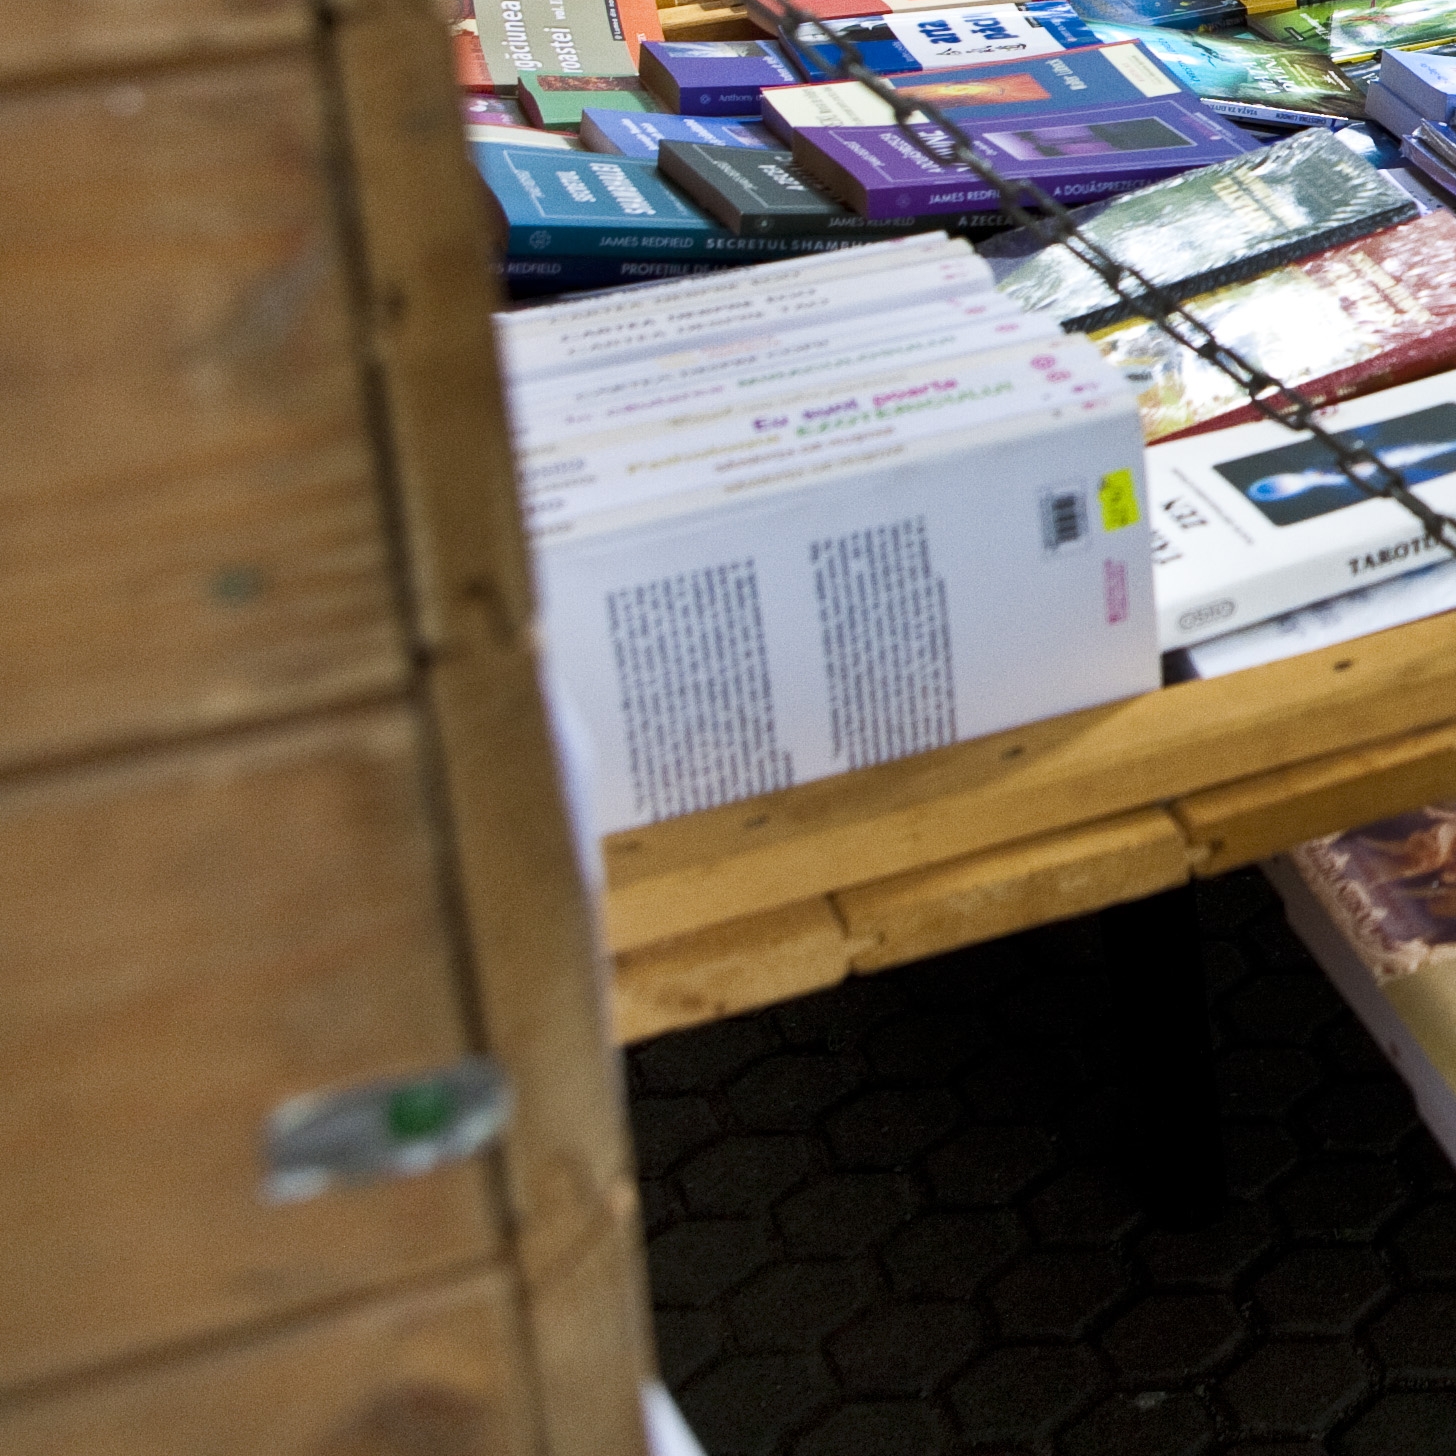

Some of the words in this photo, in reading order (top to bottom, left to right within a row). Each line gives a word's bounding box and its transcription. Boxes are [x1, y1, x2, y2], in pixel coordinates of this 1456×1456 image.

[911, 19, 962, 46] arta
[929, 192, 964, 204] JAMES
[1053, 185, 1062, 197] A
[830, 216, 862, 227] JAMES
[599, 235, 637, 247] JAMES
[639, 235, 694, 248] REDFIELD
[706, 237, 788, 249] SECRETUL
[506, 261, 562, 275] REDFIELD
[1147, 493, 1217, 533] ZEN
